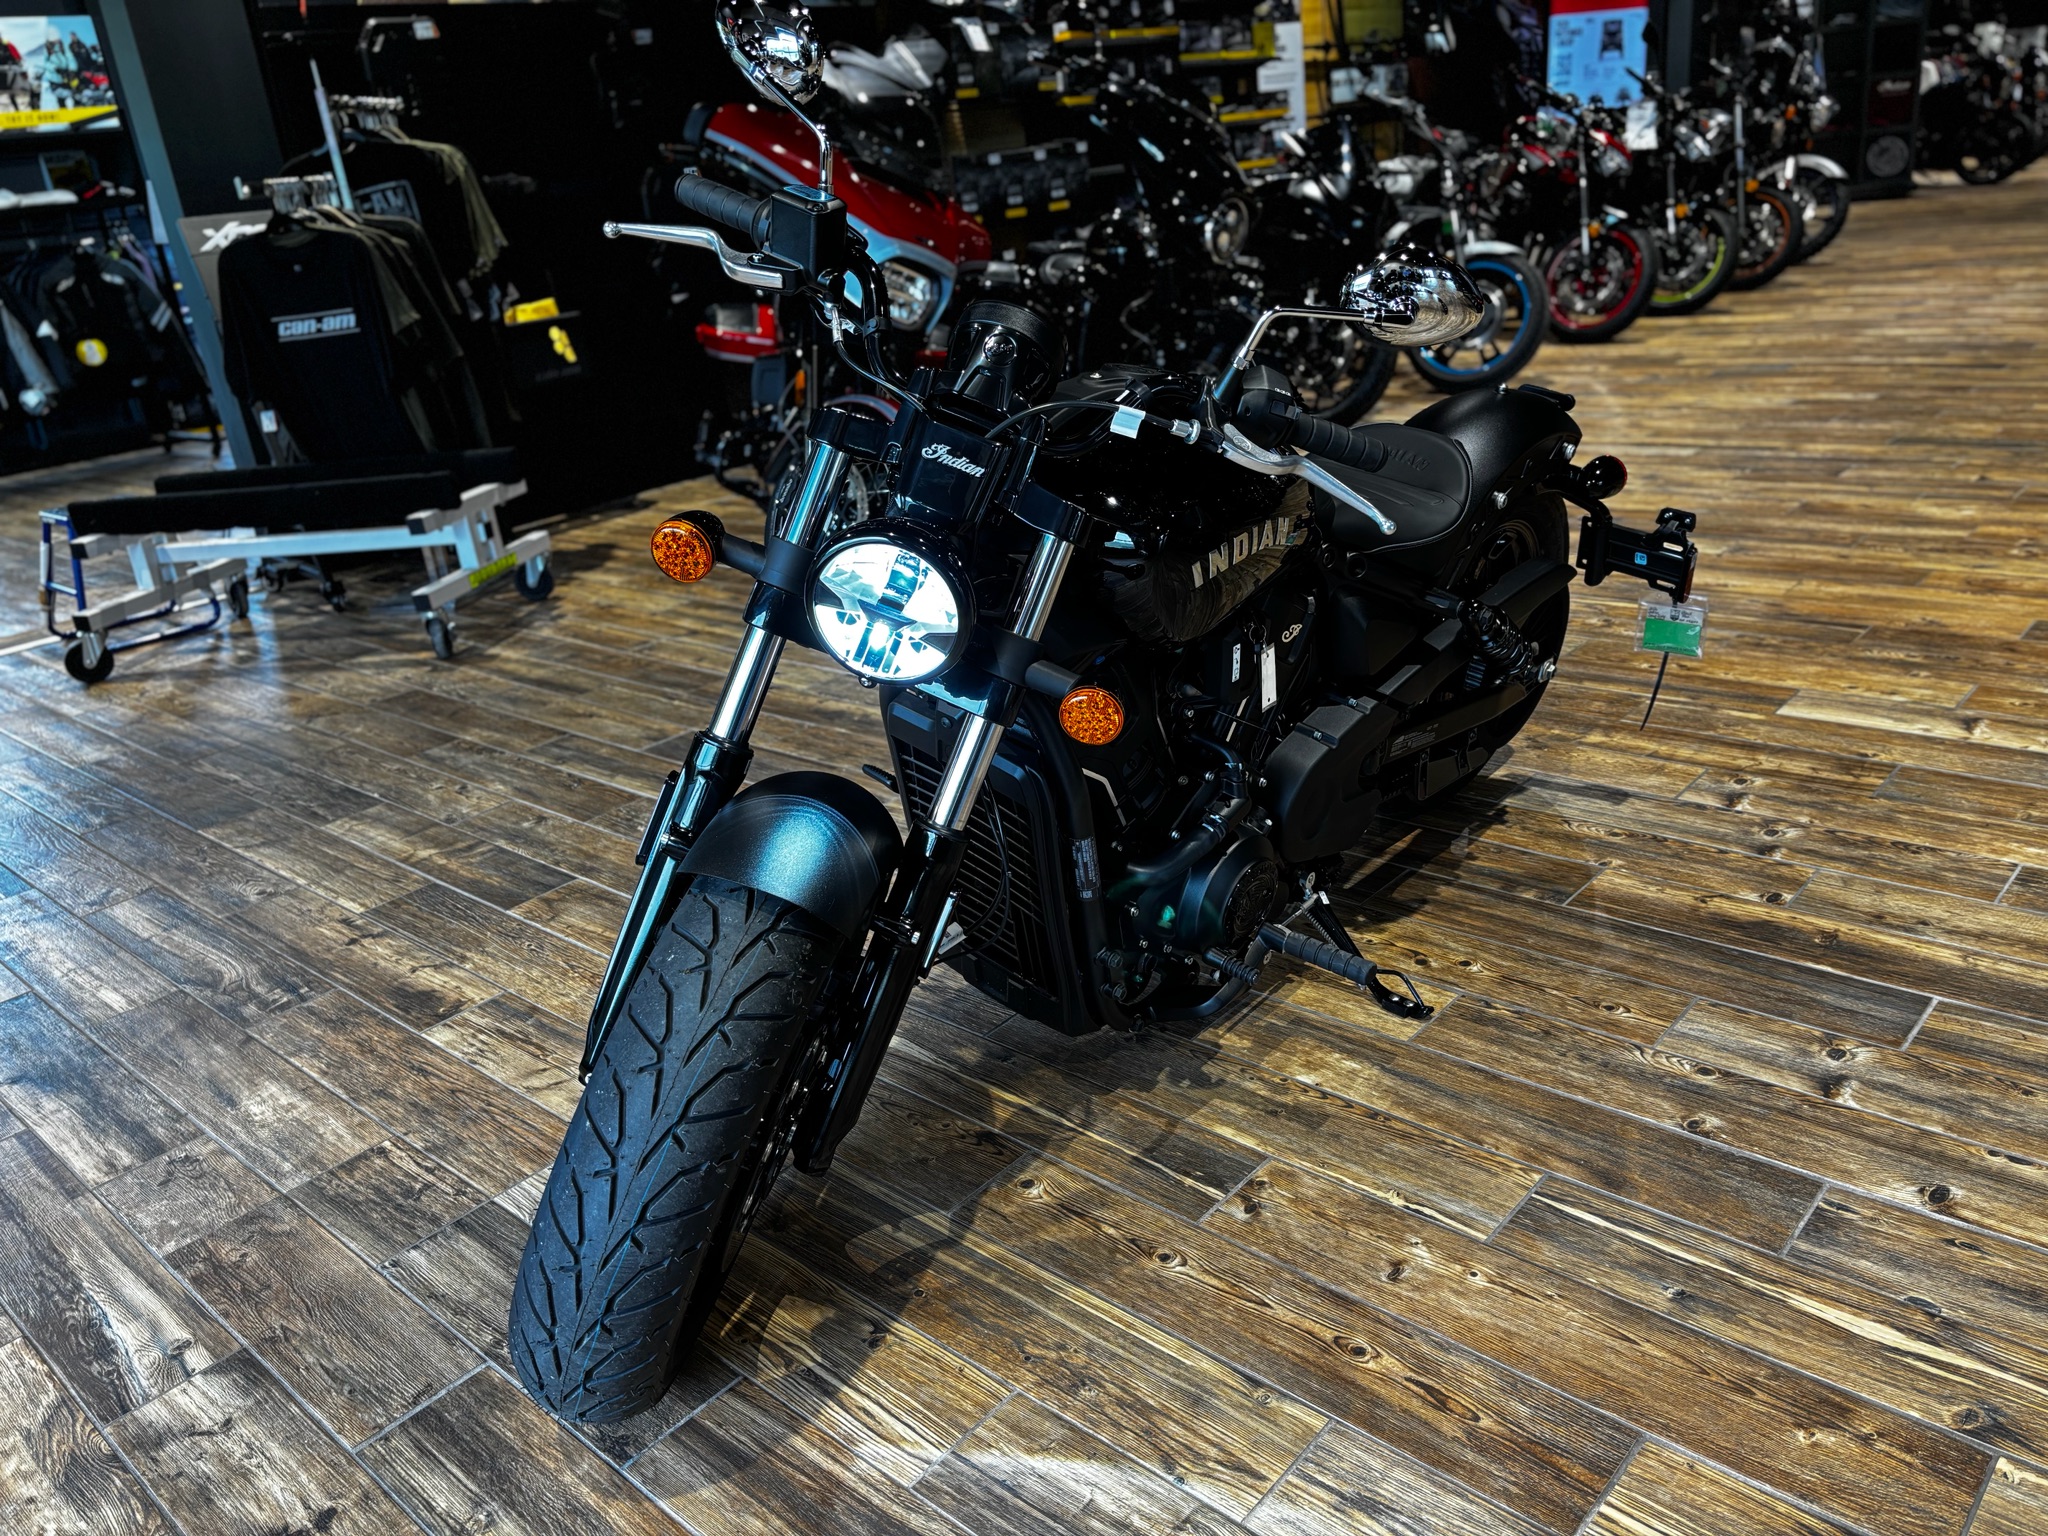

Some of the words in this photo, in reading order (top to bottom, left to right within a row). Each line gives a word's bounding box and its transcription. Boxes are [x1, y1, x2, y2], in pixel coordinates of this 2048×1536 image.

[278, 313, 357, 337] can-am
[921, 443, 985, 477] Indian
[1192, 517, 1290, 589] INDIAN
